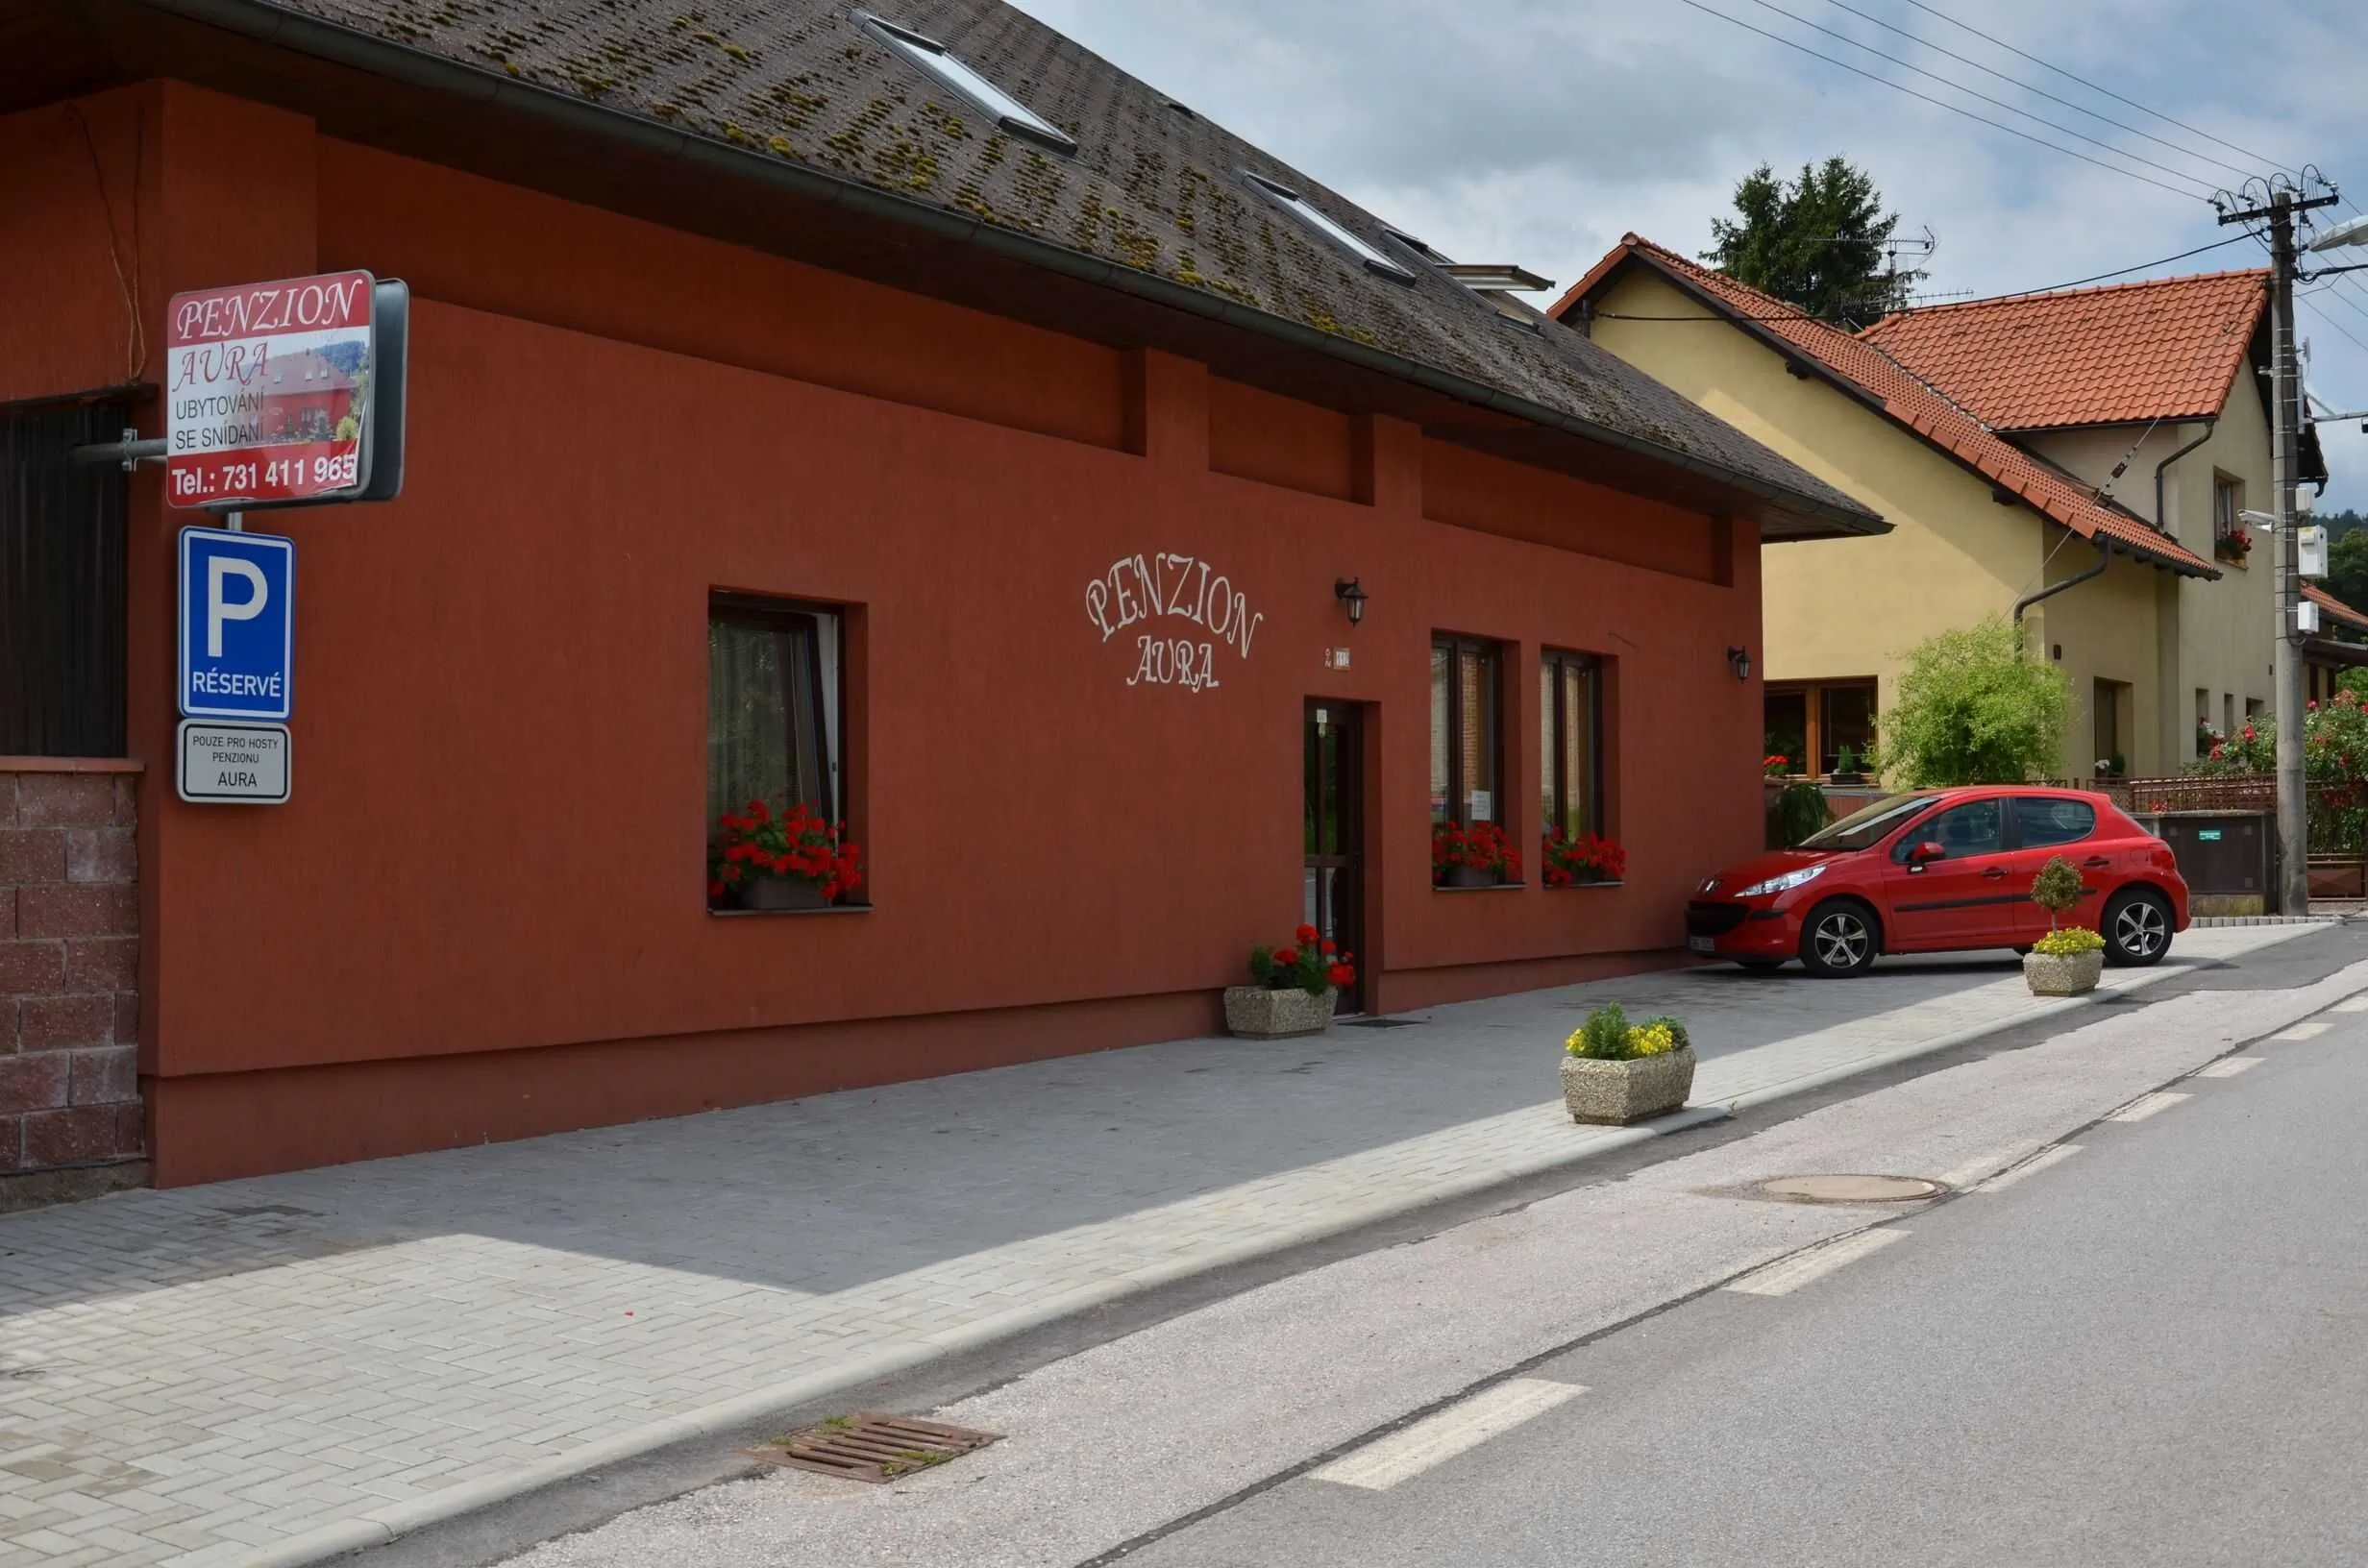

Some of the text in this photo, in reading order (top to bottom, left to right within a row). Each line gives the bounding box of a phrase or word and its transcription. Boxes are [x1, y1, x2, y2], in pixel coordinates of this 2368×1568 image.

[177, 279, 362, 339] PENZION
[172, 341, 269, 392] AURA
[176, 385, 264, 420] UBYTOVÁNÍ
[176, 430, 196, 450] SE
[172, 453, 357, 496] Tel.: 731 411 965
[208, 555, 268, 657] P
[1086, 552, 1264, 660] PENZION
[192, 667, 282, 698] RÉSERVÉ
[1126, 635, 1220, 694] AURA
[192, 735, 279, 749] POUZE PRO HOSTY
[212, 752, 259, 764] PENZIONU
[217, 772, 258, 788] AURA
